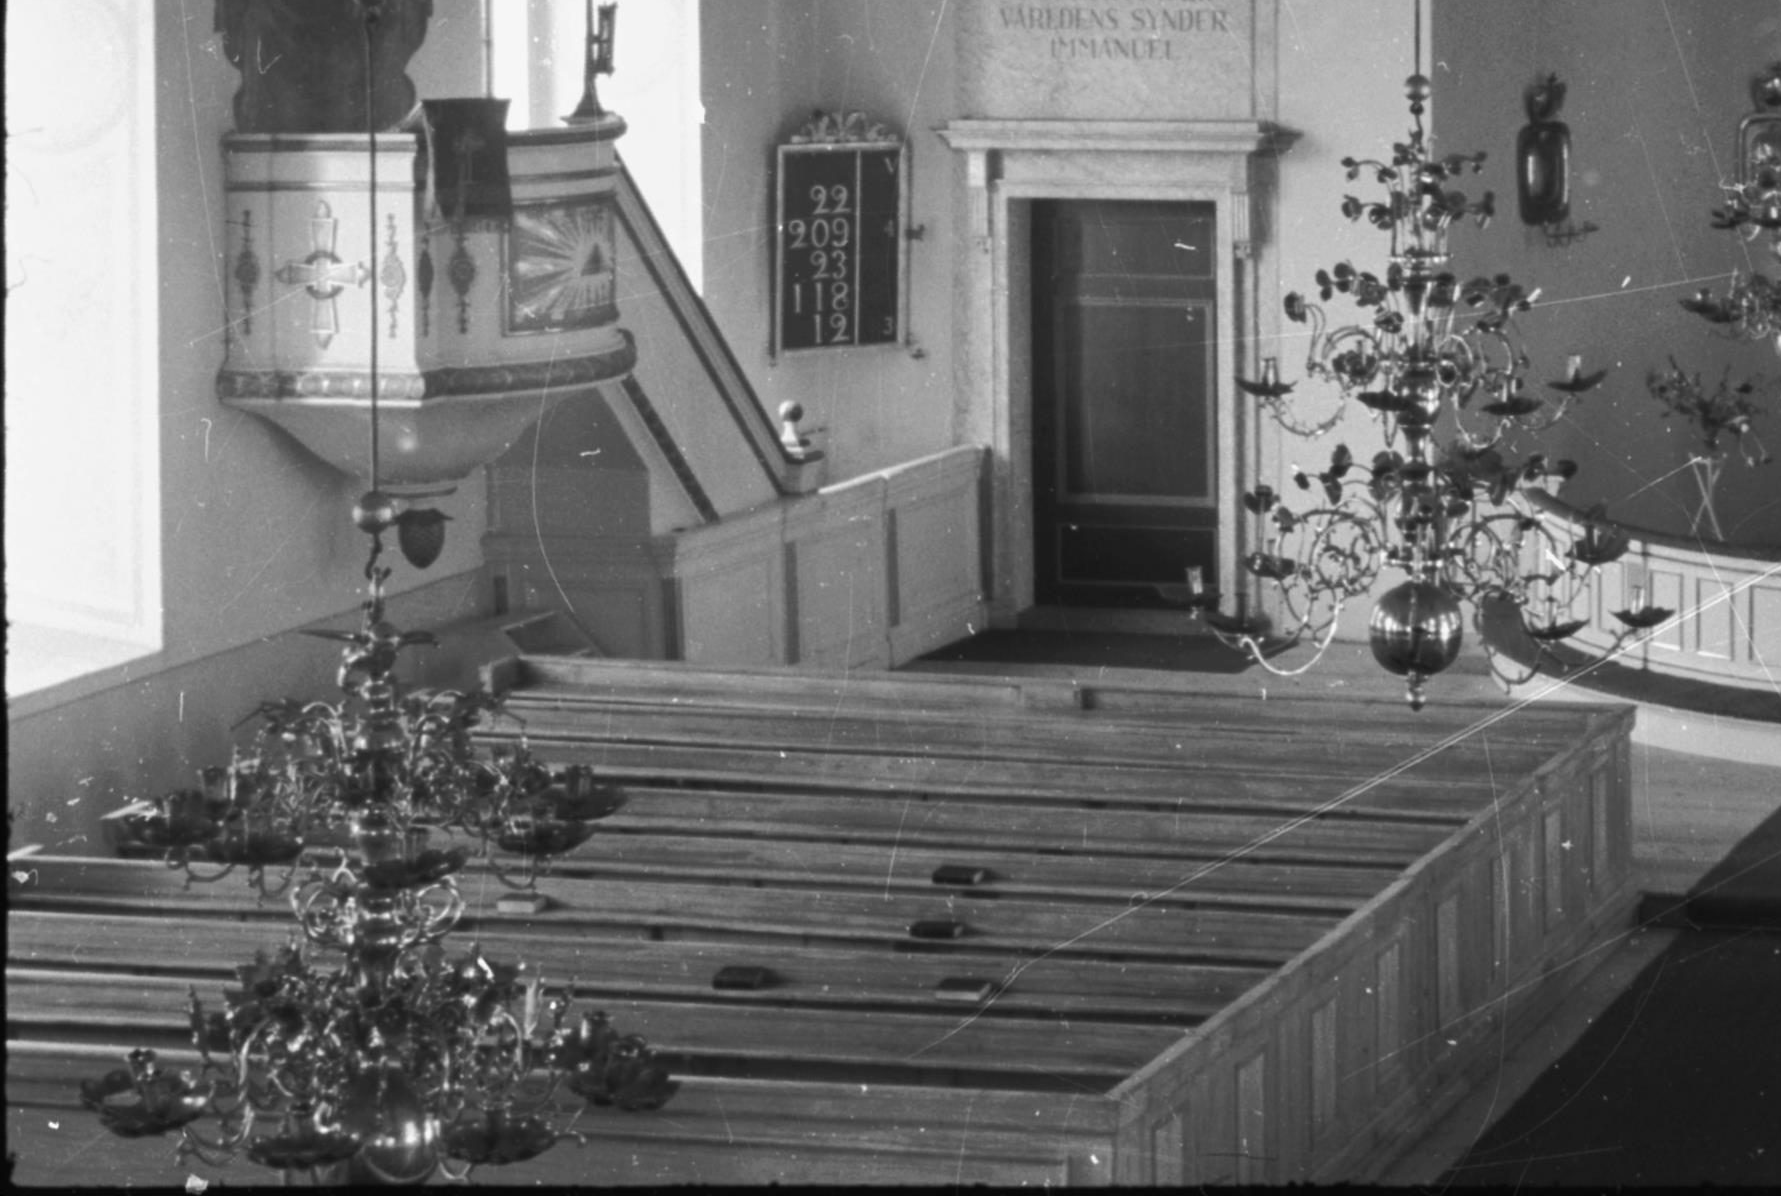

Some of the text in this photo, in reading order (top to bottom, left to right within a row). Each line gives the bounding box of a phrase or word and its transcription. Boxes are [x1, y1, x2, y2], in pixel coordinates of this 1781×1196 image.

[1131, 7, 1229, 33] SYNDER
[1051, 37, 1178, 61] IMMANUEL
[809, 184, 850, 215] 22
[788, 217, 850, 250] 209
[809, 250, 848, 280] 23
[793, 281, 849, 314] 118
[813, 312, 850, 345] 12
